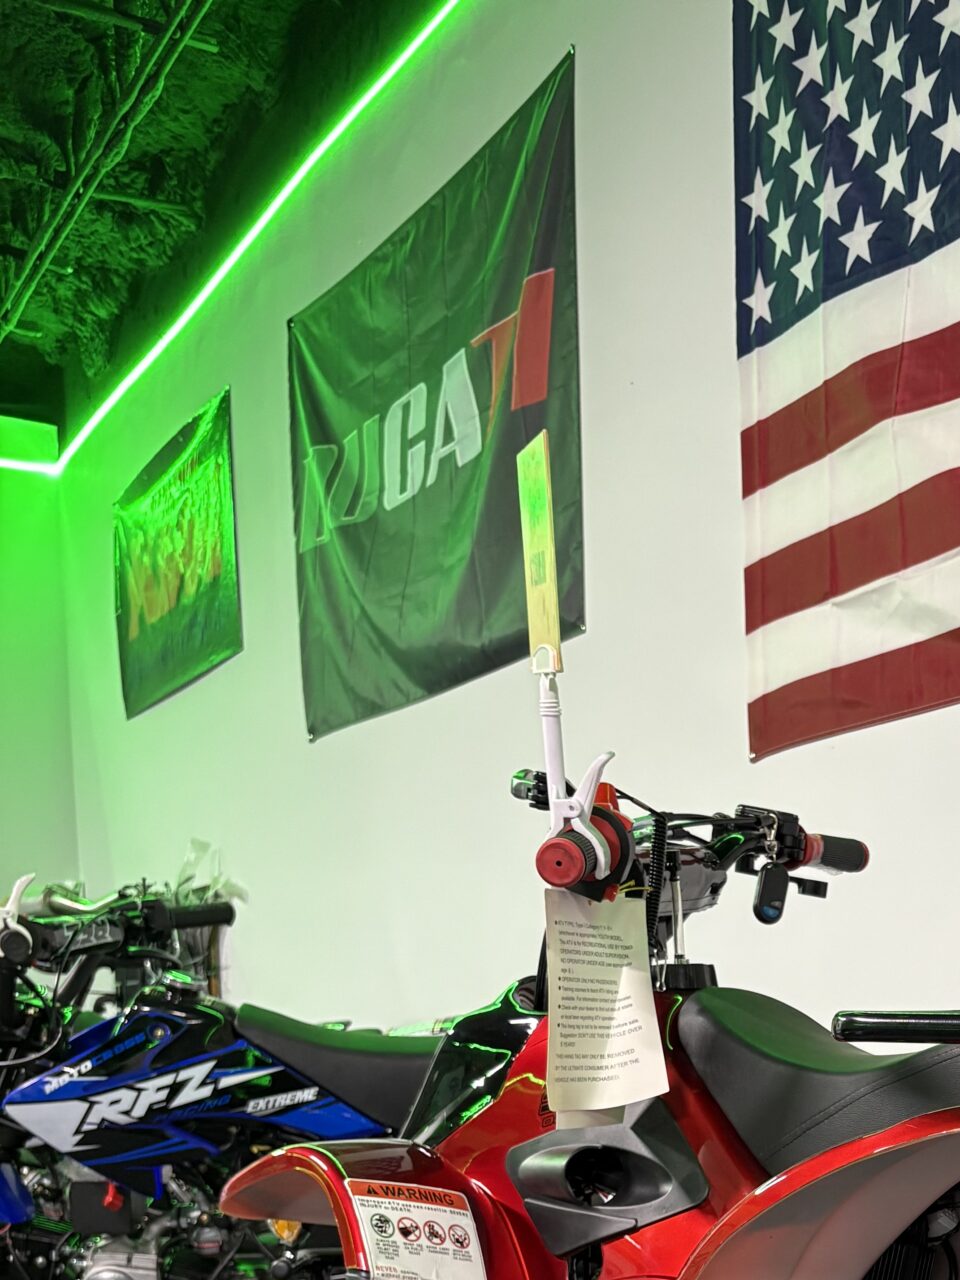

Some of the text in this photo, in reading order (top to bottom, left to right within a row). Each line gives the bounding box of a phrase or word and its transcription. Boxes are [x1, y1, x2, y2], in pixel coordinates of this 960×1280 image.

[81, 1059, 218, 1132] RFZ
[245, 1085, 320, 1114] EXTREME
[379, 1184, 456, 1206] WARNING
